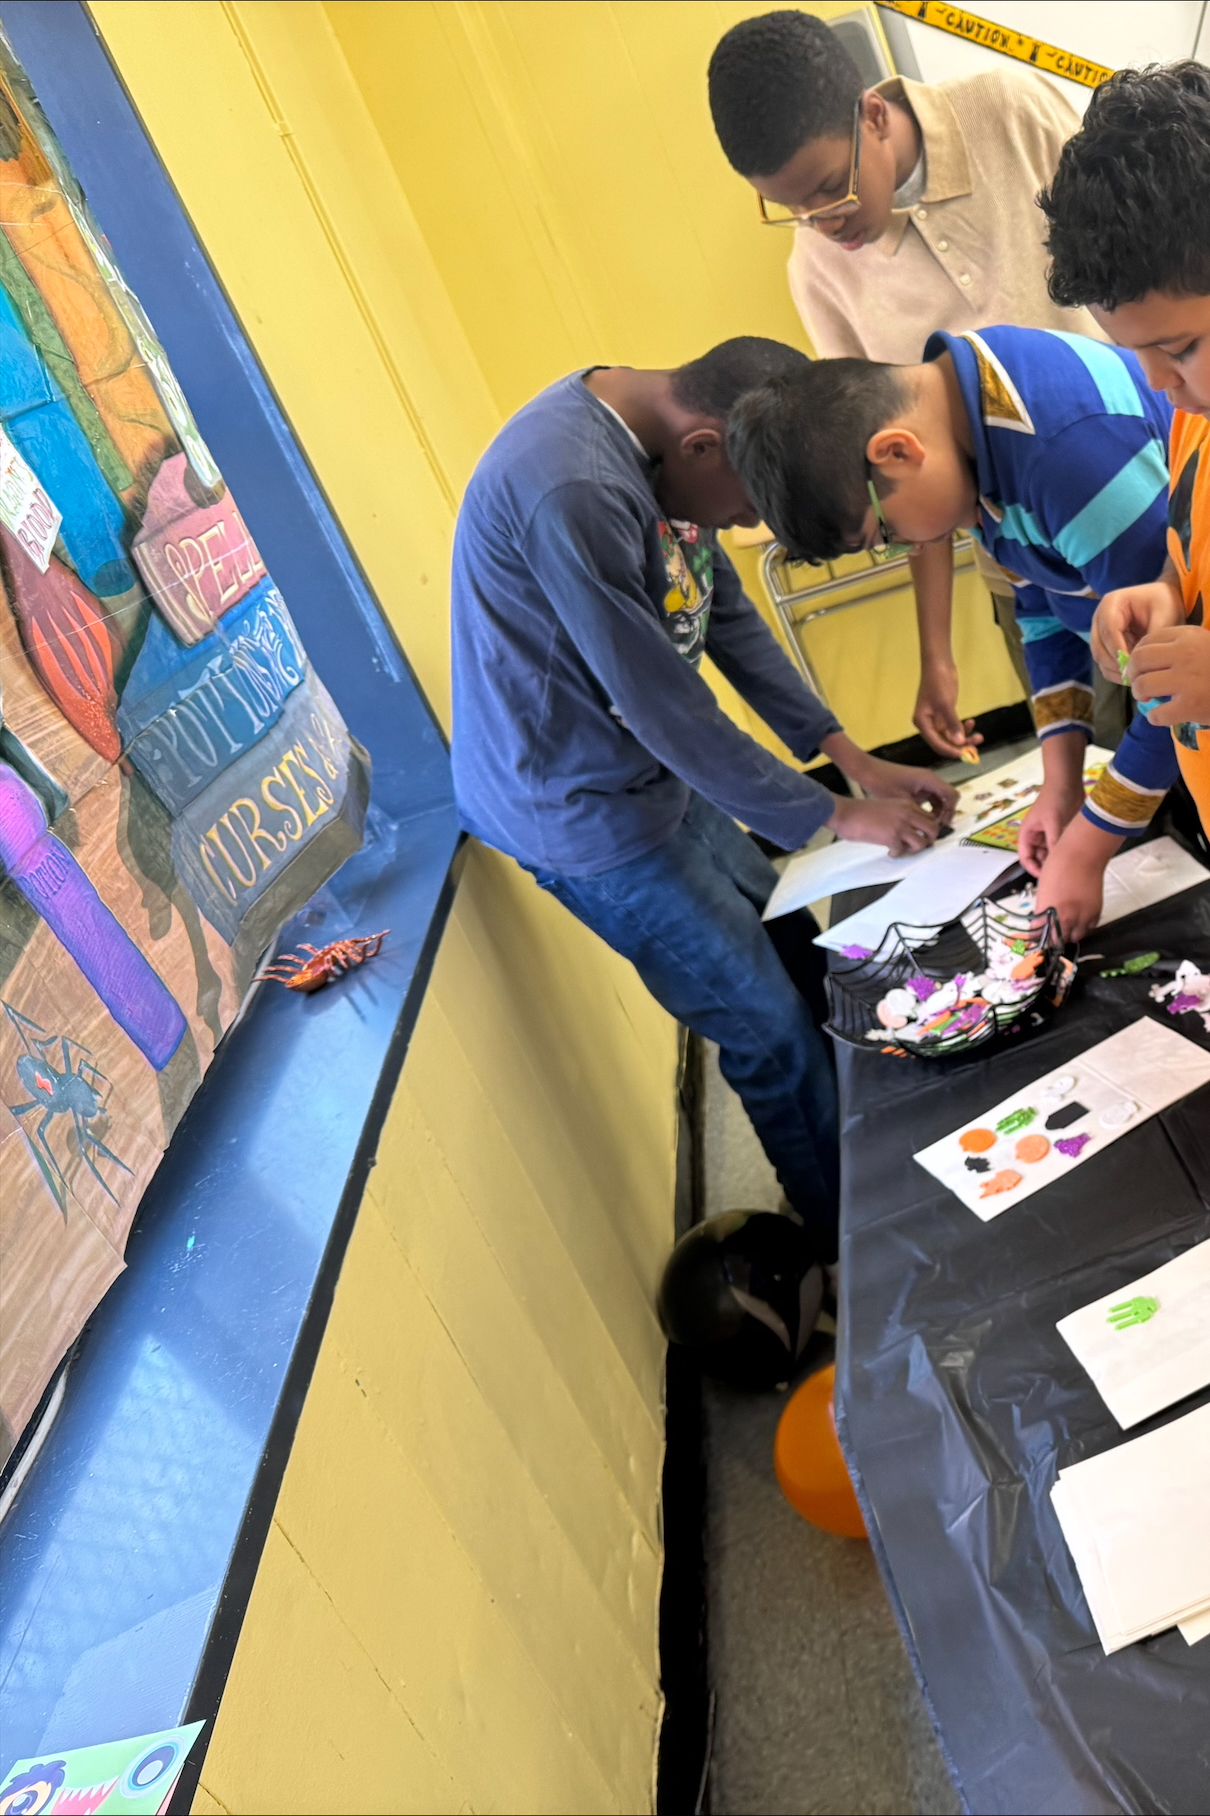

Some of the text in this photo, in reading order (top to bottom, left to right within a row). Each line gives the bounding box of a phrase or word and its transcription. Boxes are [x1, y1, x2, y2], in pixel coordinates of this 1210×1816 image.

[946, 11, 1011, 49] CAUTION
[1056, 55, 1109, 84] CAUTIO
[200, 738, 335, 908] CURSES
